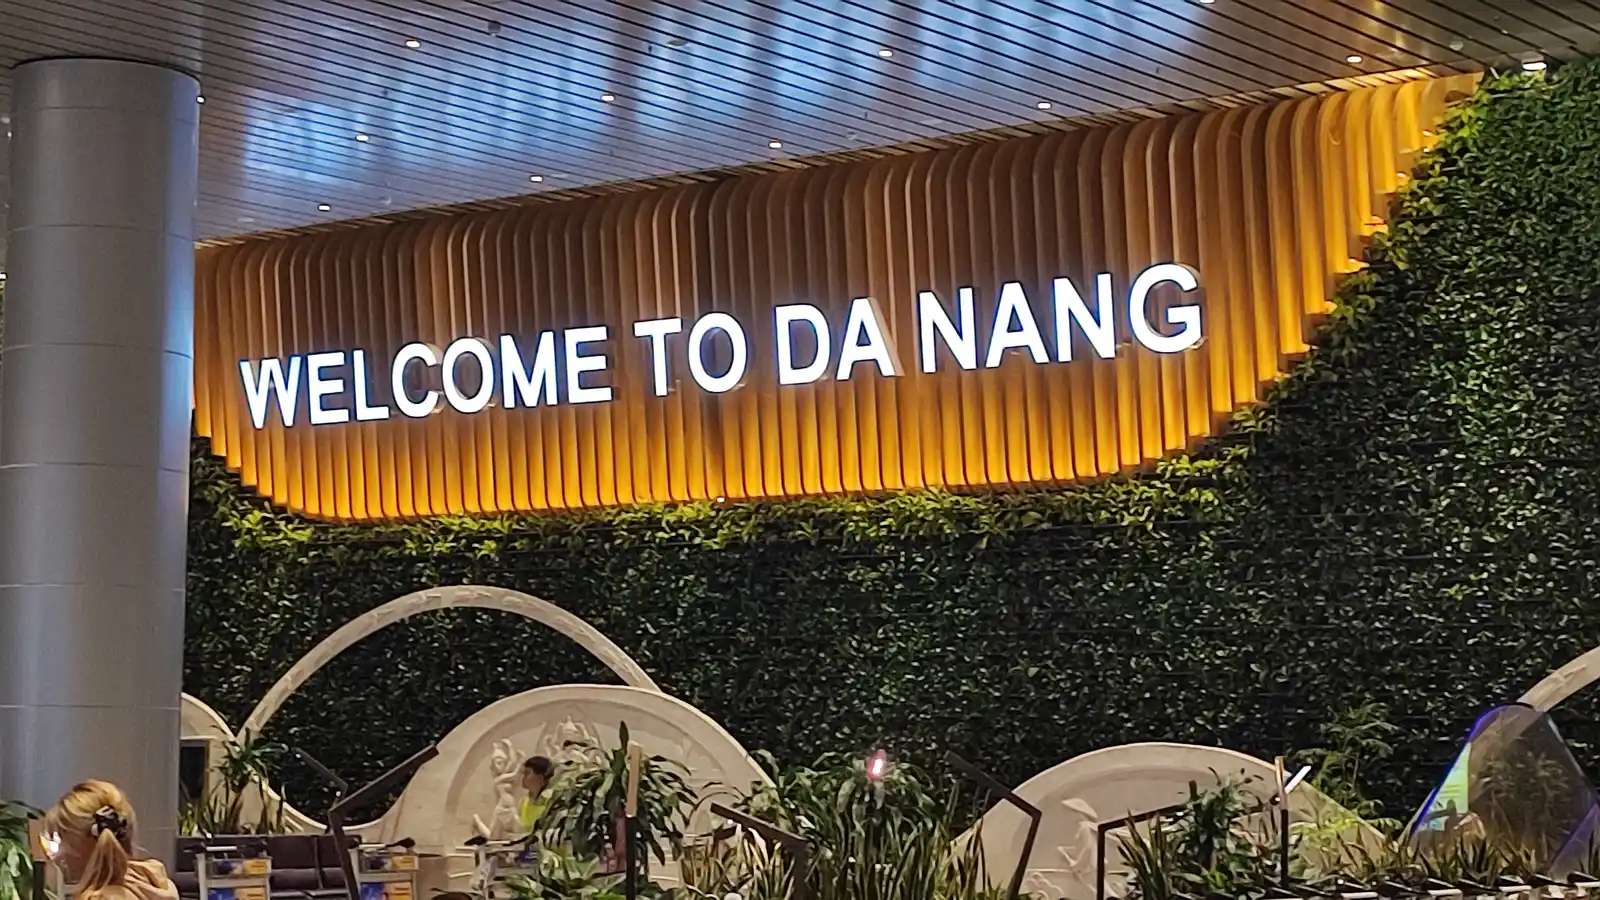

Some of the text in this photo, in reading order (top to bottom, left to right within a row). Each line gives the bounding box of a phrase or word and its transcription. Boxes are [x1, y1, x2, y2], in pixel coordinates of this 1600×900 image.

[239, 263, 1203, 429] WELCOME TO DA NANG
